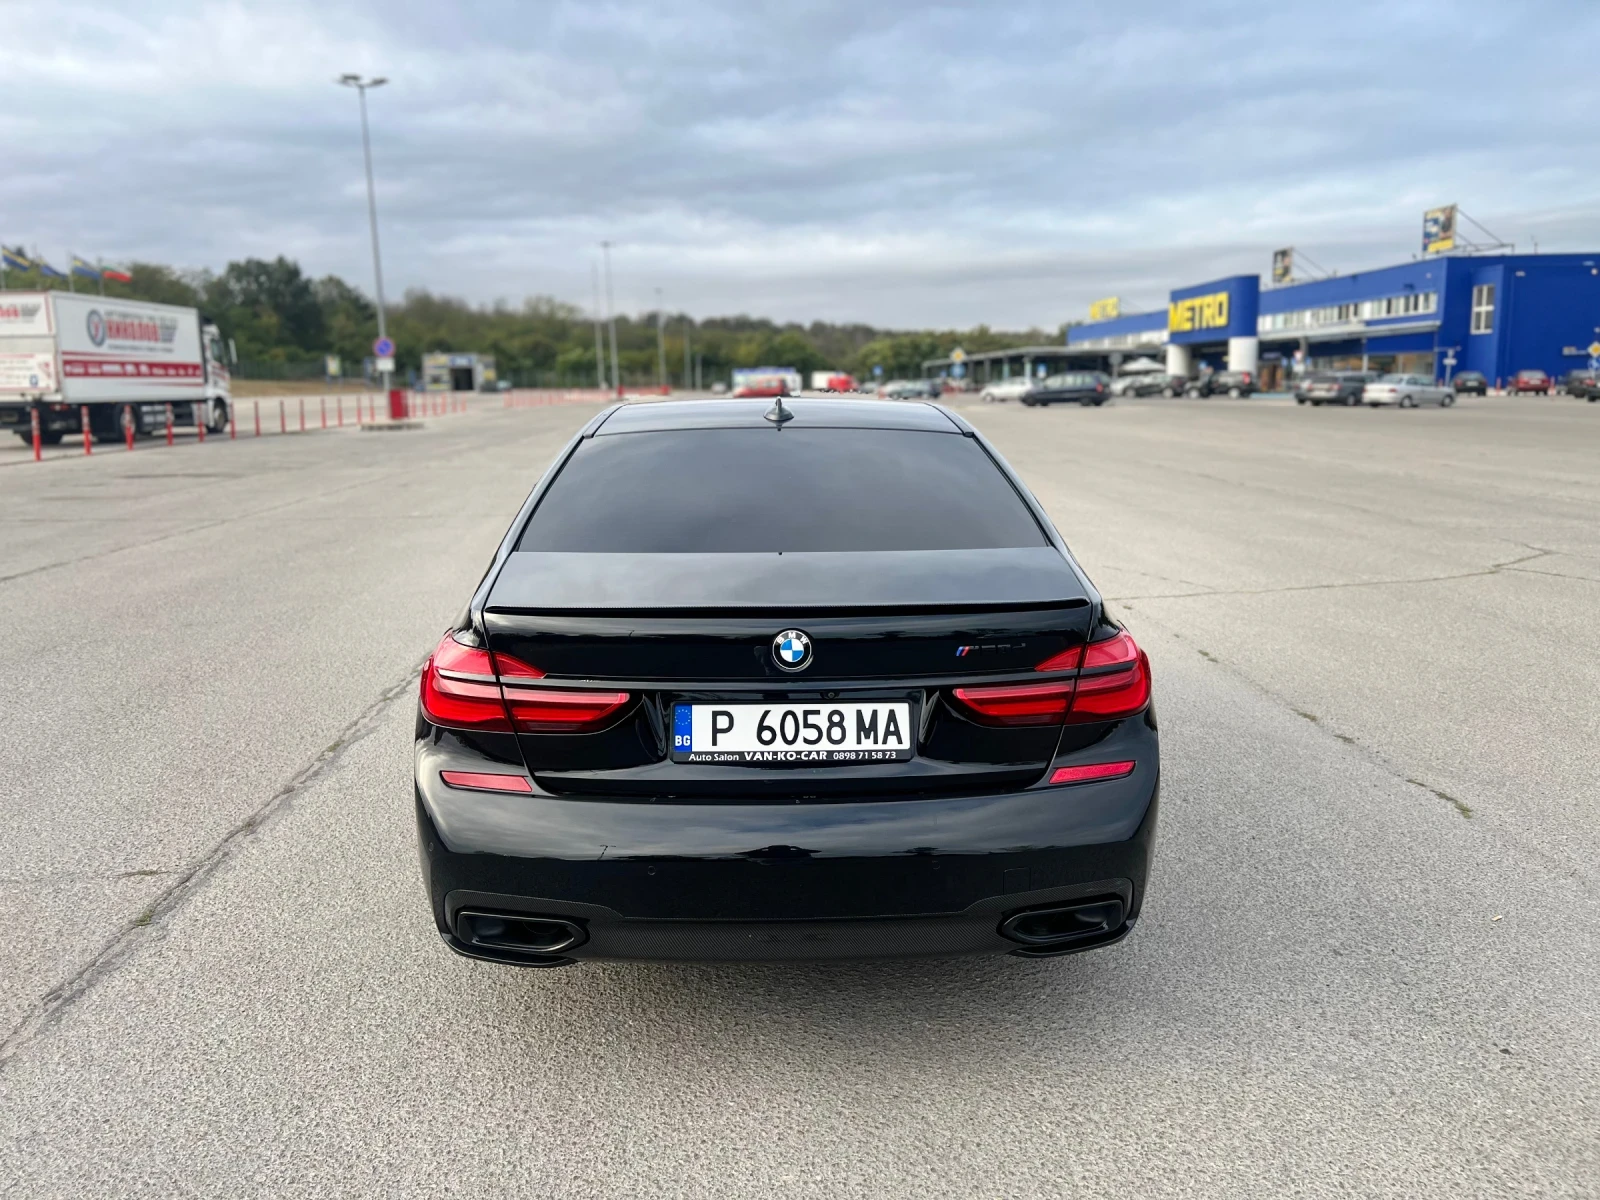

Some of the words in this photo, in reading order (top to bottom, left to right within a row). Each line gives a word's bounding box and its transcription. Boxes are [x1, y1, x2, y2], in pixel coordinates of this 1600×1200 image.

[1168, 291, 1229, 333] METRO
[776, 631, 809, 645] BMW
[711, 710, 735, 746] P
[756, 709, 847, 746] 6058
[855, 708, 904, 745] MA
[674, 735, 691, 747] BG
[688, 753, 712, 761] Auto
[713, 753, 740, 761] Salon
[744, 751, 828, 761] VAN-KO-CAR
[832, 752, 856, 760] 0898
[858, 752, 869, 760] 71
[885, 751, 897, 759] 73
